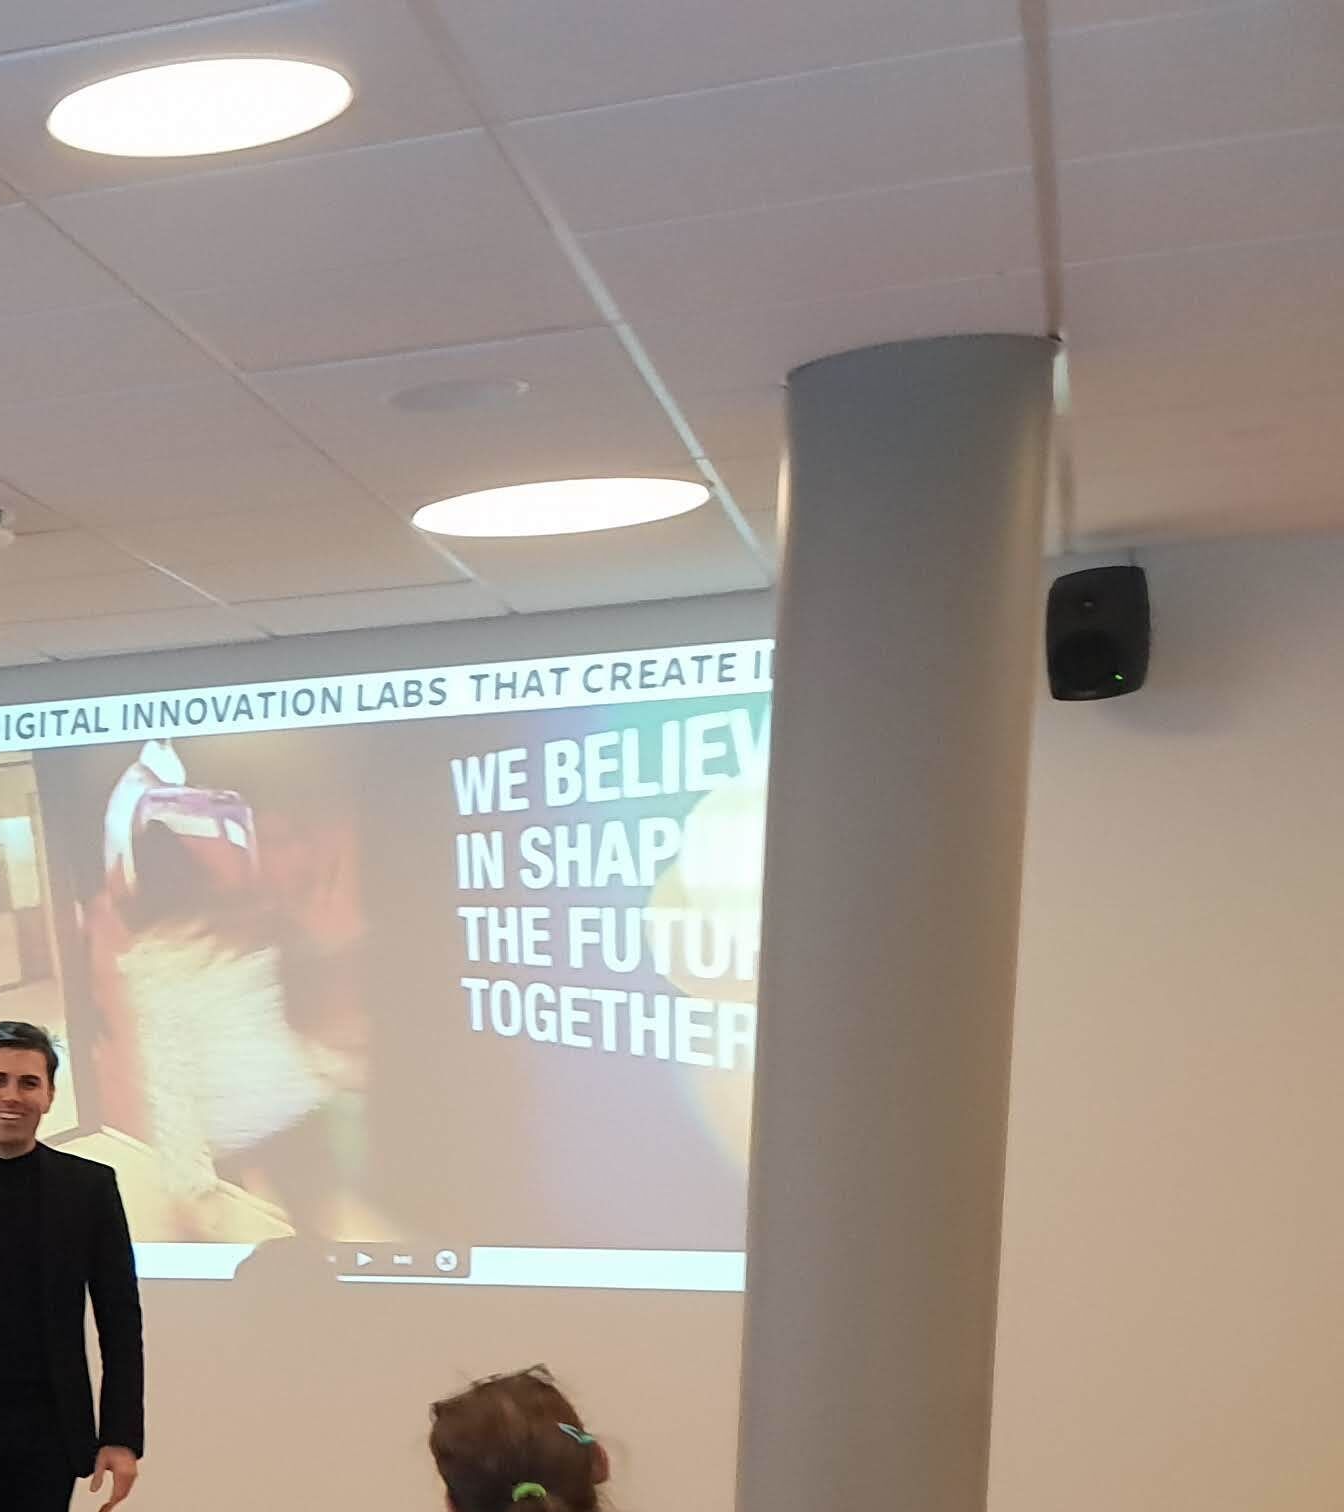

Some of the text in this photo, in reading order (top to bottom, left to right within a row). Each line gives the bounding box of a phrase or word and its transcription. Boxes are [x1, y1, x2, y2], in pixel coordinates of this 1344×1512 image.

[121, 685, 344, 731] INNOVATION
[357, 677, 448, 712] LABS
[469, 667, 570, 702] THAT
[582, 652, 738, 694] CREATE
[450, 748, 530, 816] WE
[456, 817, 683, 889] IN SHAP
[457, 906, 553, 967] THE
[461, 977, 758, 1070] TOGETHER
